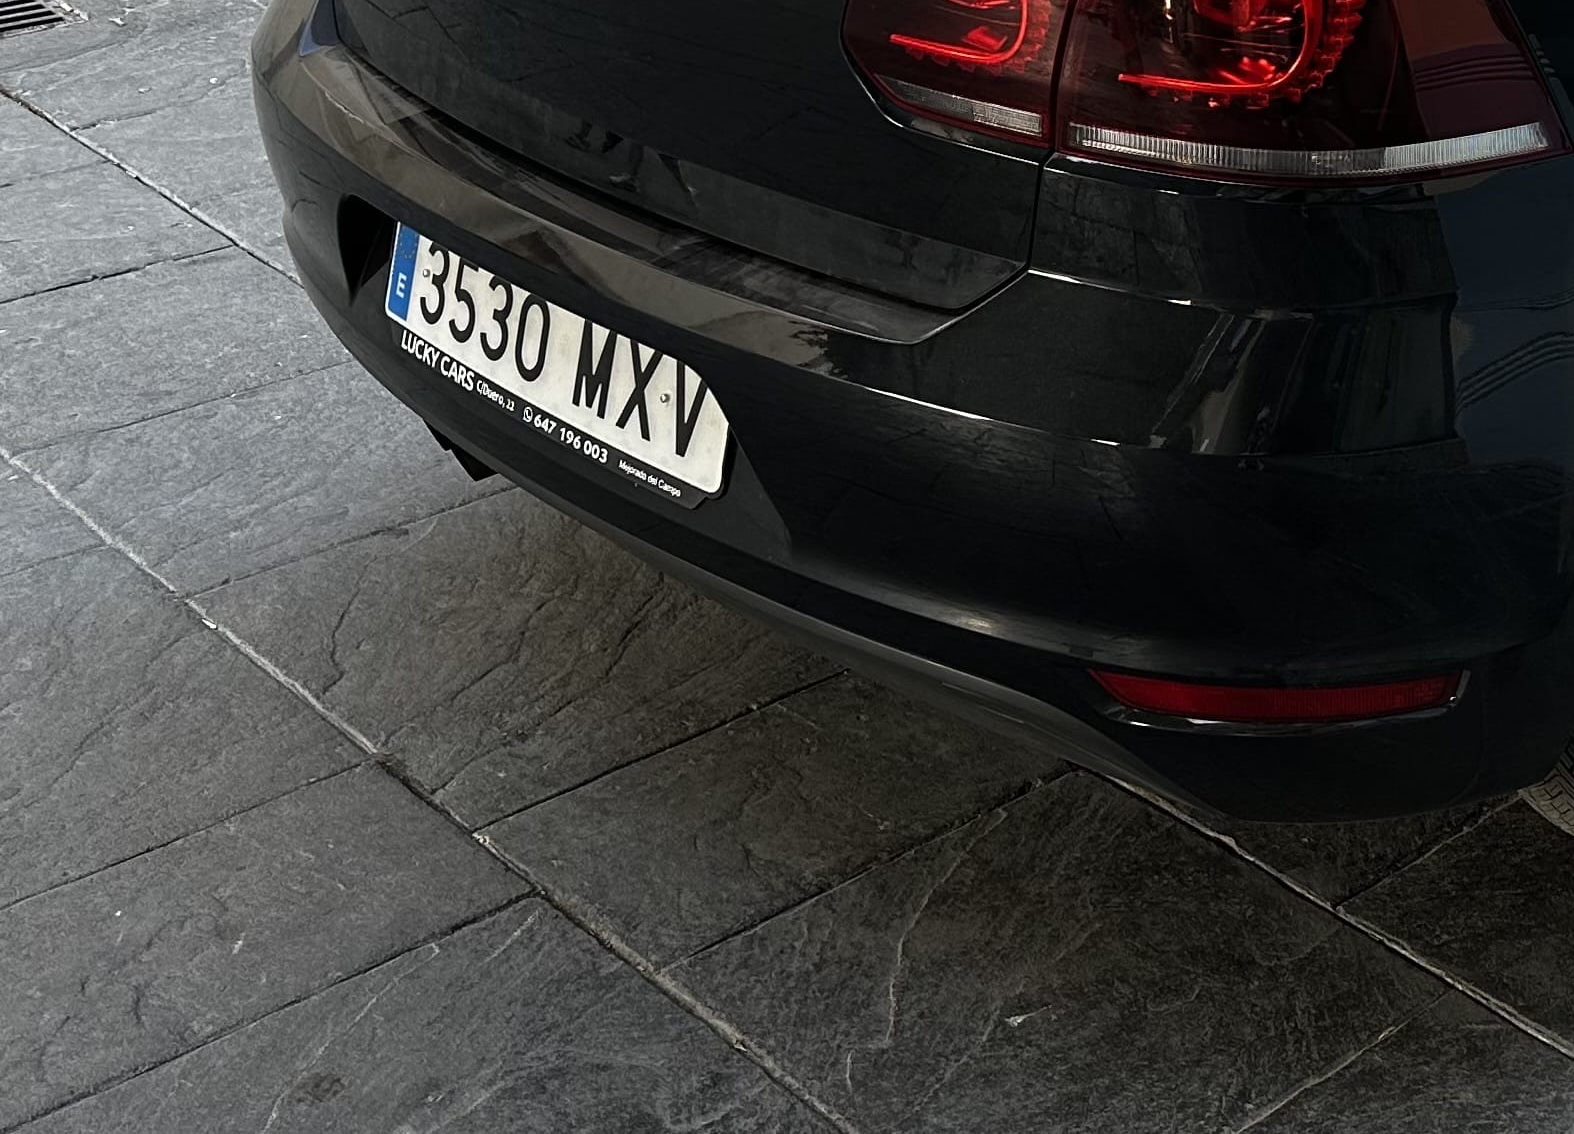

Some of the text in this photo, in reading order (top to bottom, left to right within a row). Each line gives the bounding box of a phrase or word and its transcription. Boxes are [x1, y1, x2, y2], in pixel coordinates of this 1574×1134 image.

[394, 273, 406, 298] E
[401, 329, 440, 368] LUCKY
[440, 355, 475, 392] CARS
[420, 240, 708, 458] 3530 MXV
[534, 414, 609, 464] 647 196 003
